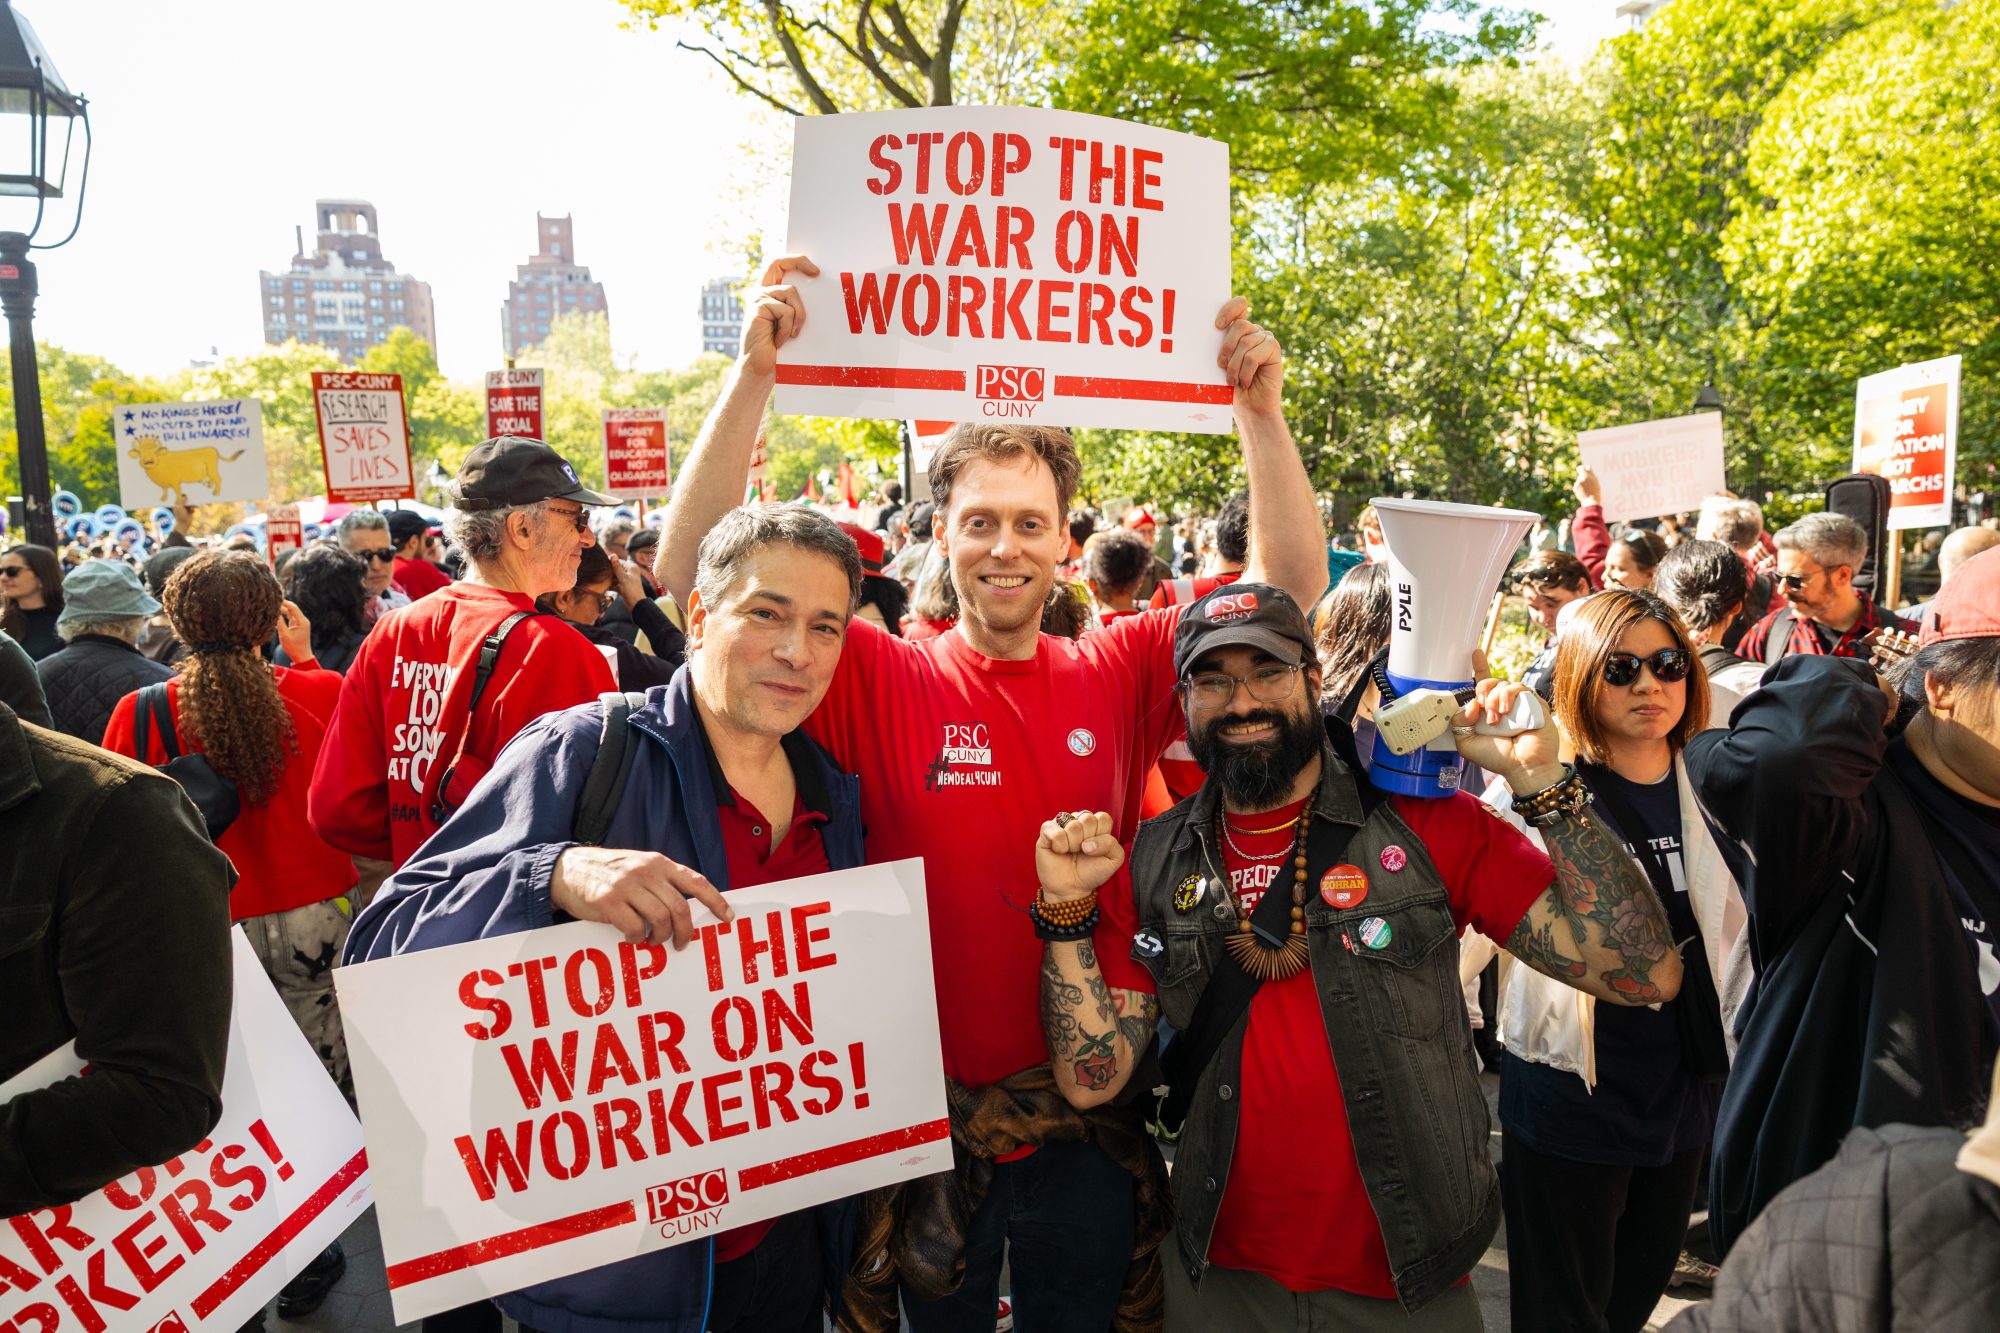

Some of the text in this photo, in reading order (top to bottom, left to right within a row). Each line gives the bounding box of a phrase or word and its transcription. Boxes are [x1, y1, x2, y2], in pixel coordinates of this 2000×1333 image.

[866, 131, 1164, 212] STOP THE
[887, 202, 1140, 278] WAR ON
[839, 271, 1176, 354] WORKERS!
[321, 374, 395, 389] PSC-CUNY
[978, 367, 1044, 402] PSC
[140, 401, 242, 419] NO KINGS HERE!
[321, 392, 388, 421] RESEARCH
[490, 396, 539, 412] SAVE THE
[981, 402, 1037, 418] CUNY
[161, 419, 194, 430] CUTS
[197, 419, 212, 429] TO
[215, 416, 247, 427] FUND
[162, 427, 250, 441] BILLIONAIRES!
[496, 416, 534, 433] SOCIAL
[617, 426, 654, 438] MONEY
[334, 426, 391, 453] SAVES
[626, 437, 647, 449] FOR
[608, 448, 665, 460] EDUCATION
[627, 460, 649, 470] NOT
[350, 455, 400, 482] LIVES
[609, 469, 666, 481] OLIGARCHS
[1206, 592, 1257, 616] PSC
[1398, 583, 1412, 632] PYLE
[1210, 611, 1254, 624] CUNY
[408, 683, 444, 727] LO
[943, 723, 990, 749] PSC
[947, 749, 986, 763] CUNY
[388, 757, 410, 780] AT
[1647, 836, 1680, 850] TEL
[1230, 864, 1281, 893] PEOP
[1321, 880, 1366, 890] ZOHRAN
[1960, 917, 1986, 933] NJ
[456, 900, 838, 1041] STOP THE
[500, 981, 815, 1110] WAR ON
[453, 1041, 870, 1202] WORKERS!
[646, 1167, 729, 1224] PSC
[659, 1207, 725, 1240] CUNY
